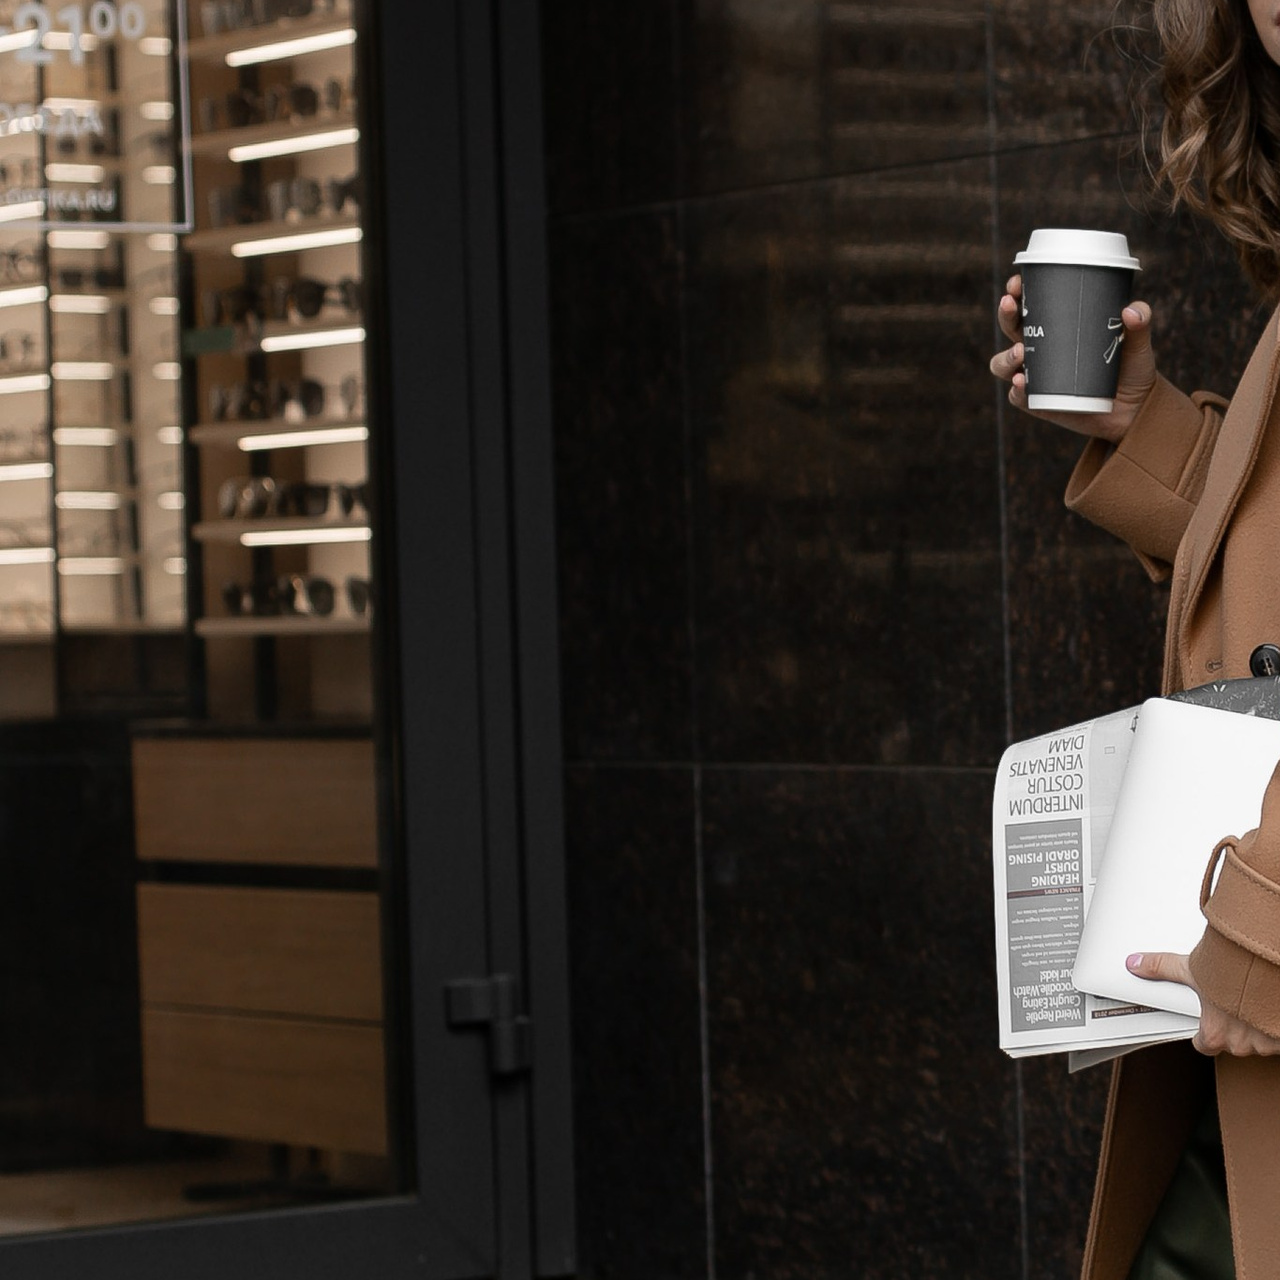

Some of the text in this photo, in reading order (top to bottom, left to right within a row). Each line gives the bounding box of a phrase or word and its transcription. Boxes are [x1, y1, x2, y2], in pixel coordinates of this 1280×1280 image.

[1048, 734, 1085, 754] DIAM
[1009, 753, 1084, 778] VENENATIS
[1027, 773, 1084, 794] COSTUR
[1009, 793, 1084, 817] INTERDUM
[1008, 849, 1080, 865] ORADI PISING
[1044, 861, 1079, 874] DURST
[1031, 873, 1080, 887] HEADING
[1040, 969, 1074, 982] our kids!
[1022, 993, 1081, 1010] Caught Eating
[1026, 1008, 1081, 1024] Weird Reptile
